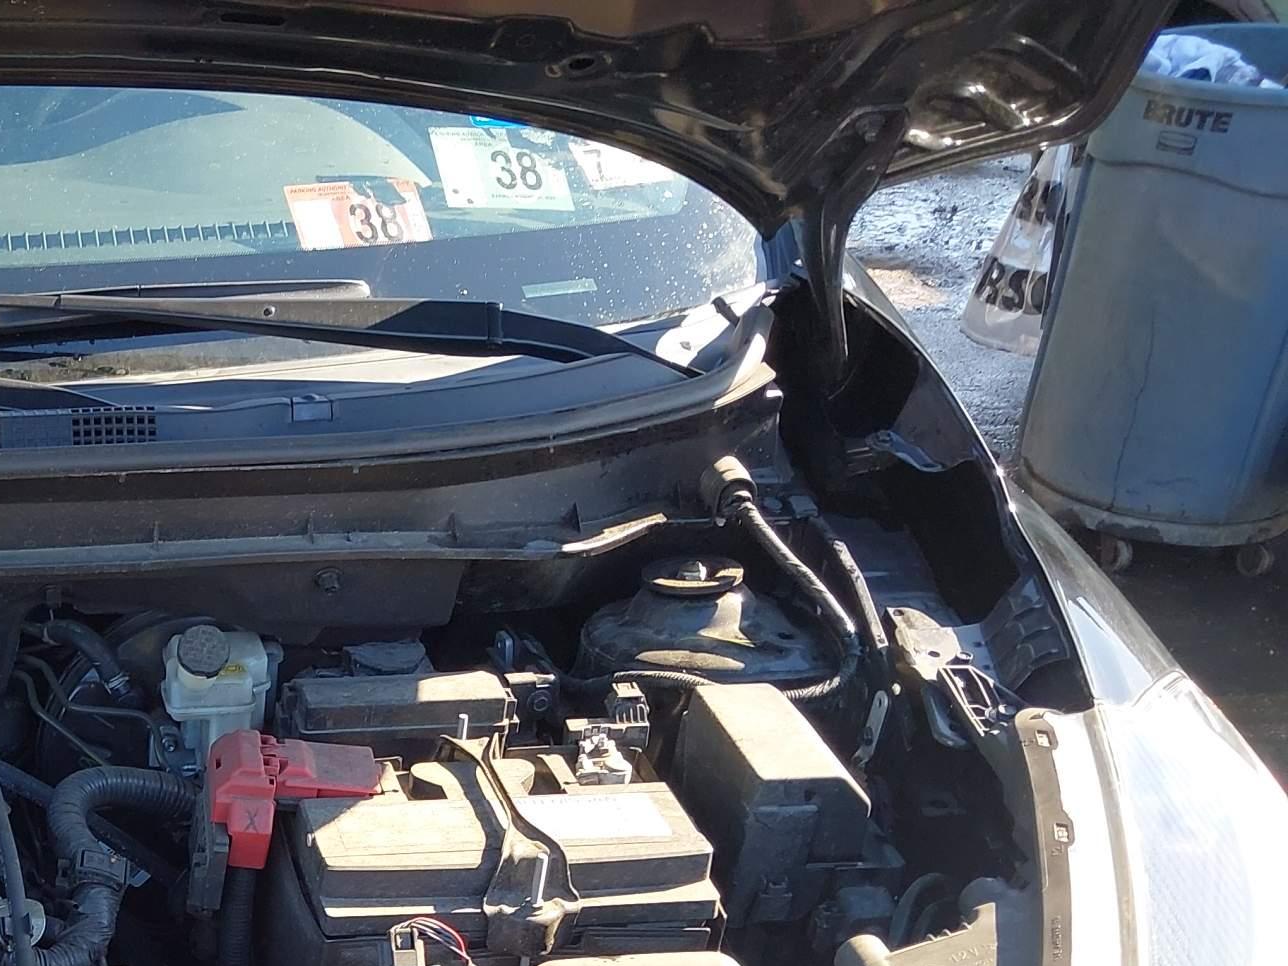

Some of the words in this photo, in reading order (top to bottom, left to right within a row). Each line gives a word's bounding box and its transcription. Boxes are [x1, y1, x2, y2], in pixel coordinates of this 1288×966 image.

[1143, 99, 1233, 133] BRUTE
[490, 150, 543, 191] 38
[349, 203, 404, 243] 38
